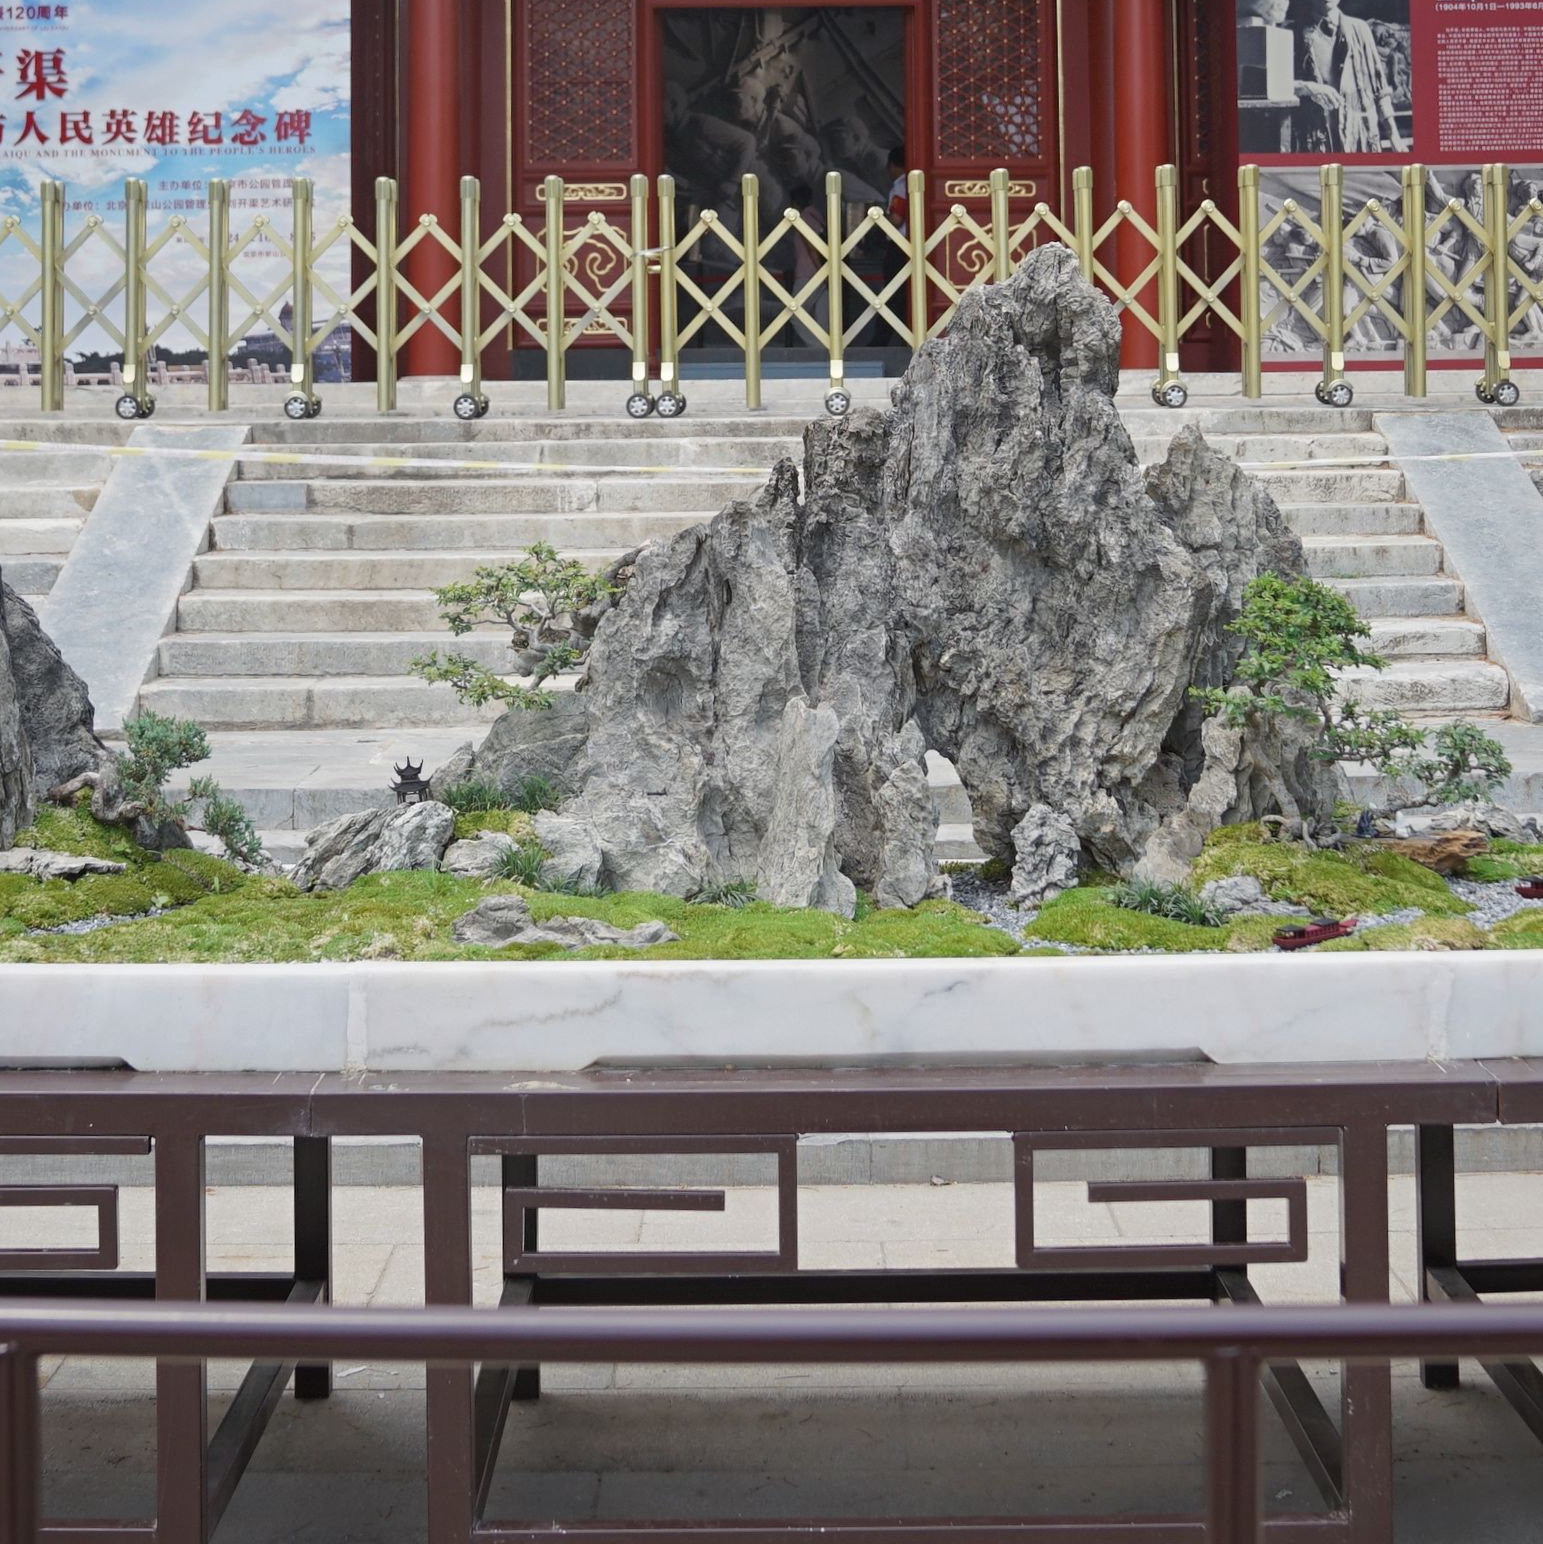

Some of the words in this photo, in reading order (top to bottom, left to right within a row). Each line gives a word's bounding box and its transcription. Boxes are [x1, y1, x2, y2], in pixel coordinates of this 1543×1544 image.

[36, 149, 60, 158] AND
[64, 149, 86, 158] THE
[90, 147, 157, 158] MONUMENT
[164, 147, 178, 157] TO
[183, 146, 204, 156] THE
[210, 146, 265, 156] PEOPLE'S
[269, 145, 316, 155] HEROES
